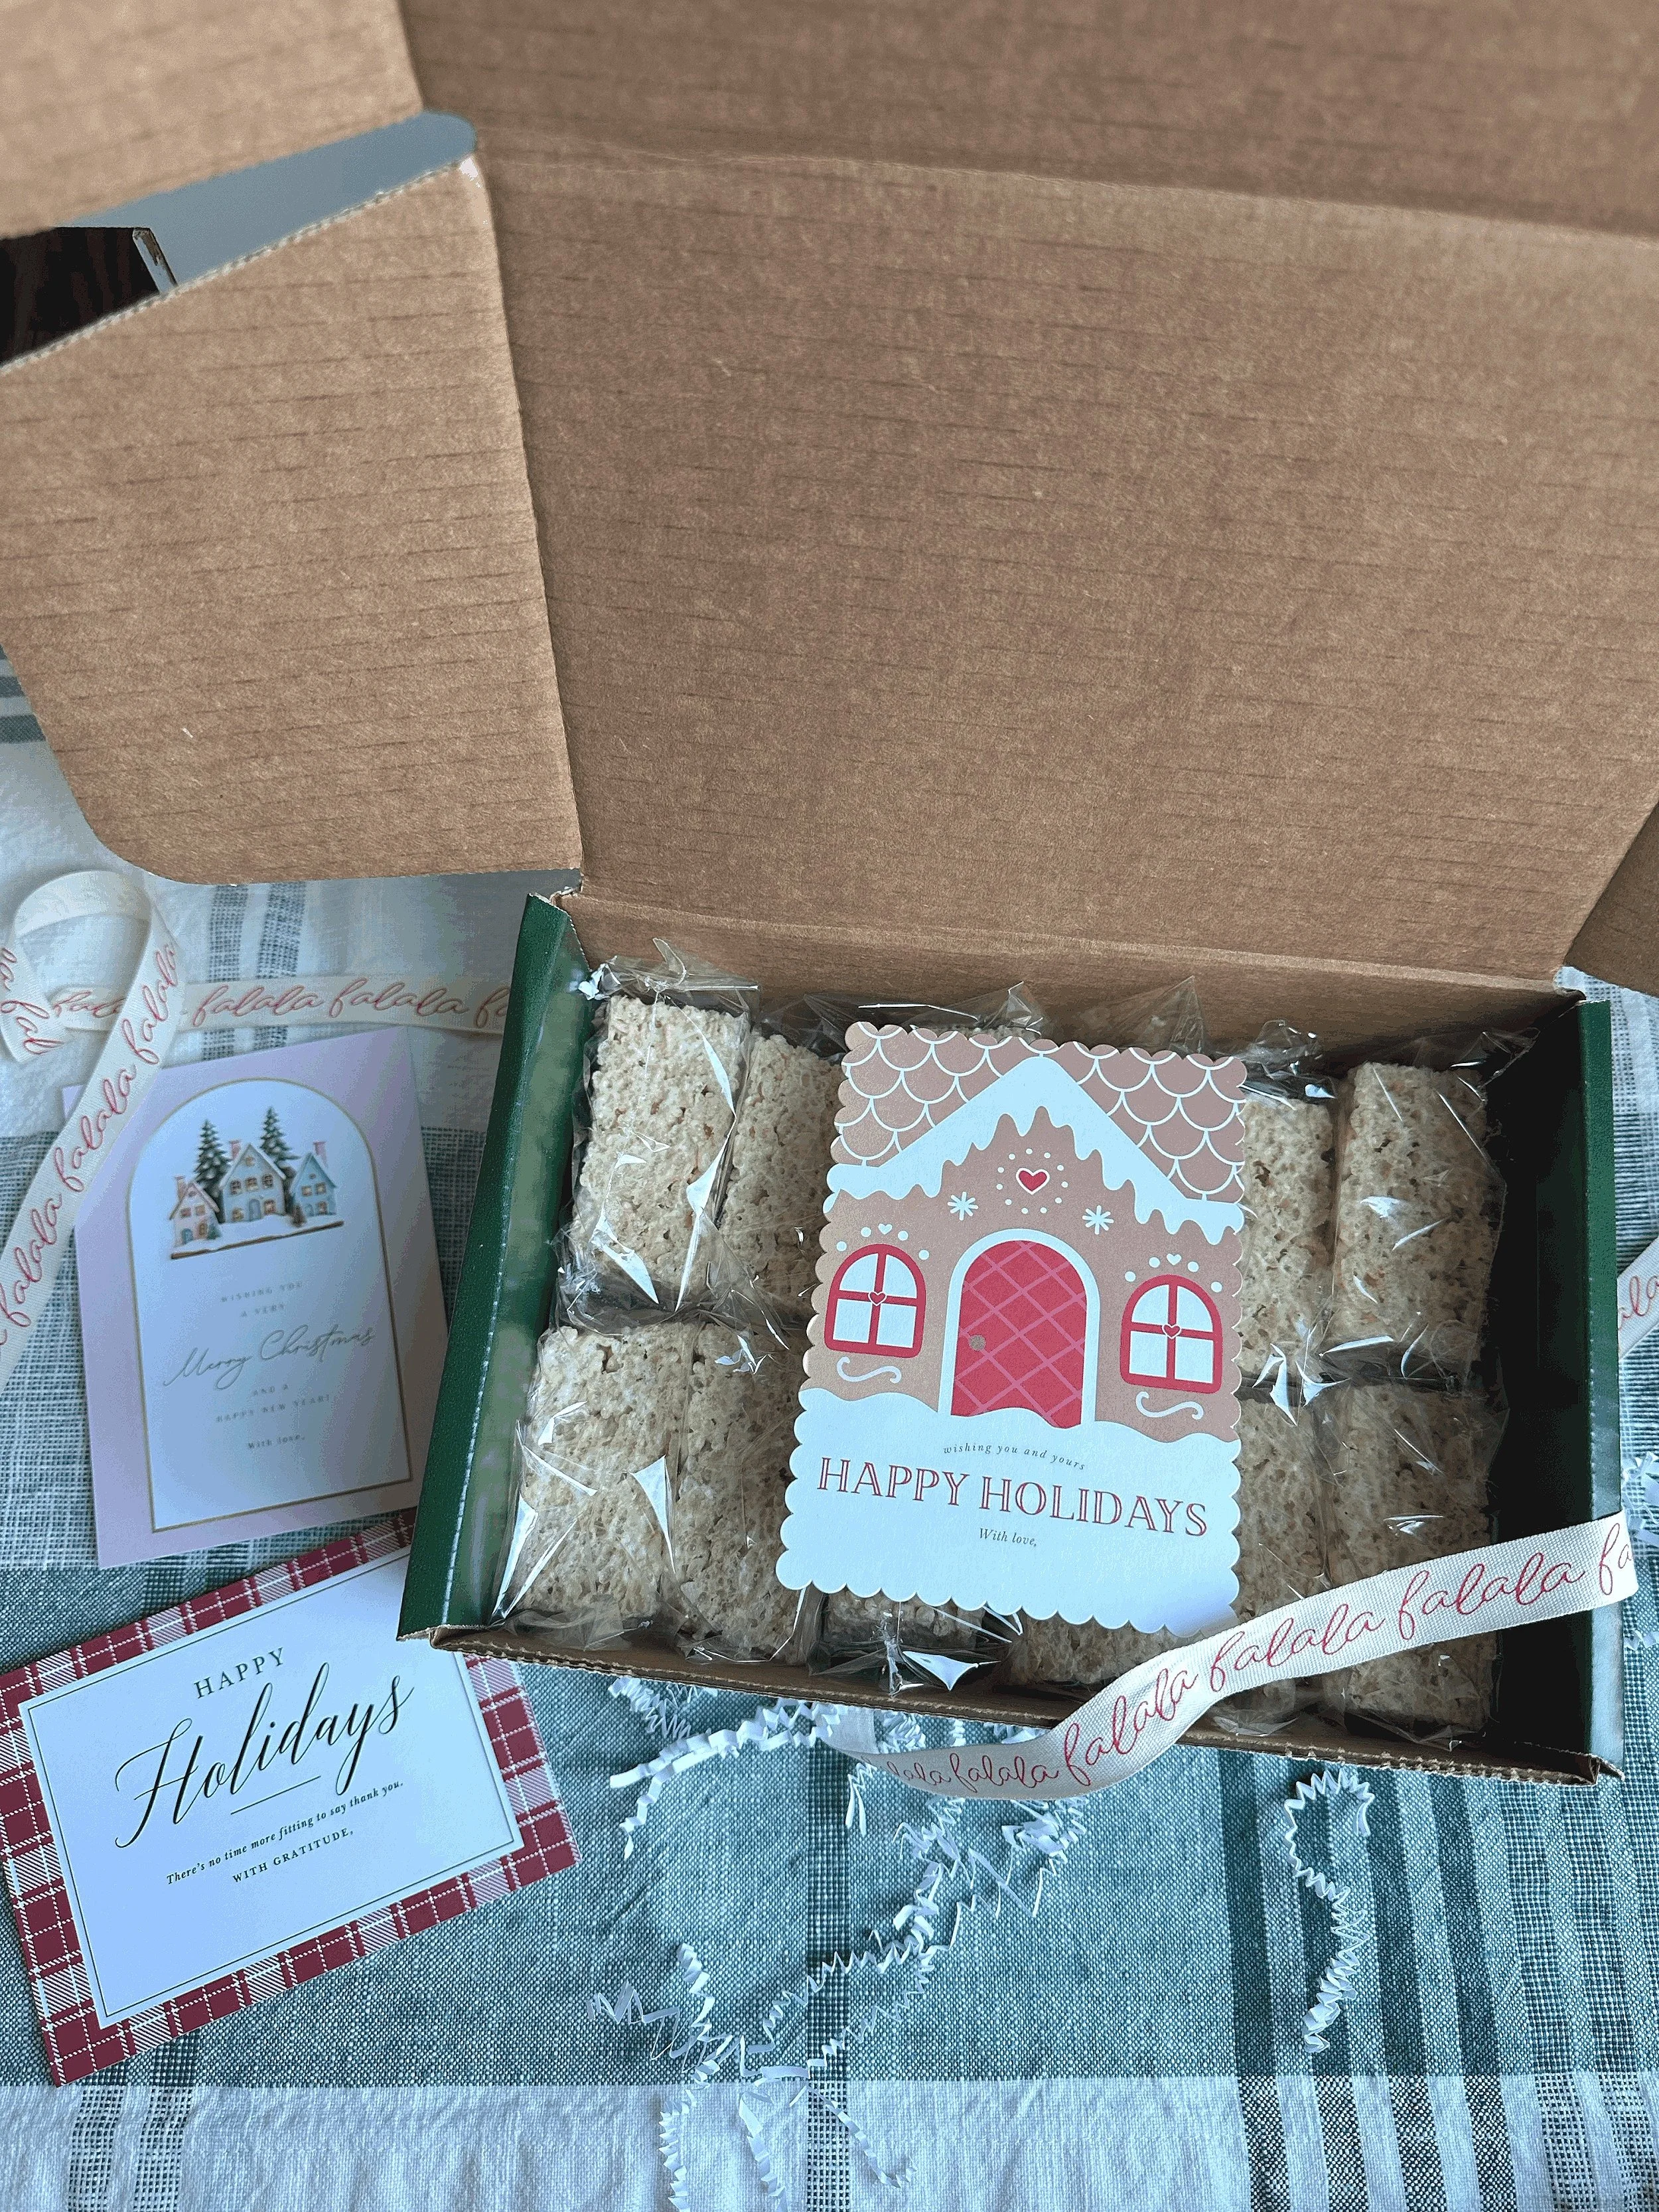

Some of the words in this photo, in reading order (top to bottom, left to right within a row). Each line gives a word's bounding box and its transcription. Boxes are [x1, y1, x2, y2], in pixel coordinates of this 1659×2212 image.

[192, 984, 323, 1027] falala
[328, 978, 469, 1019] falala
[54, 1064, 137, 1192] falala
[221, 1288, 272, 1302] WISHING
[255, 1303, 285, 1315] VERY
[163, 1347, 254, 1390] Merry
[259, 1324, 376, 1363] Christmas
[216, 1409, 254, 1423] HAPPY
[261, 1402, 286, 1414] NEW
[252, 1385, 275, 1396] AND
[248, 1438, 272, 1449] With
[944, 1442, 992, 1454] wishing
[996, 1445, 1019, 1455] you
[1024, 1448, 1048, 1459] and
[1050, 1455, 1086, 1471] yours
[816, 1457, 970, 1507] HAPPY
[978, 1475, 1208, 1537] HOLIDAYS
[979, 1528, 1008, 1542] With
[1012, 1532, 1037, 1547] love,
[194, 1647, 284, 1698] HAPPY
[950, 1752, 1060, 1793] falala
[1063, 1668, 1200, 1787] falala
[1210, 1603, 1386, 1693] falala
[1398, 1552, 1586, 1641] falala
[115, 1662, 415, 1848] Holidays
[167, 1862, 206, 1885] There's
[208, 1856, 222, 1867] no
[224, 1844, 248, 1860] time
[251, 1834, 277, 1850] more
[279, 1817, 314, 1841] fitting
[317, 1810, 326, 1822] to
[330, 1803, 346, 1816] say
[349, 1787, 379, 1808] thank
[382, 1781, 403, 1797] you.
[232, 1862, 269, 1883] WITH
[273, 1827, 354, 1866] GRATITUDE,
